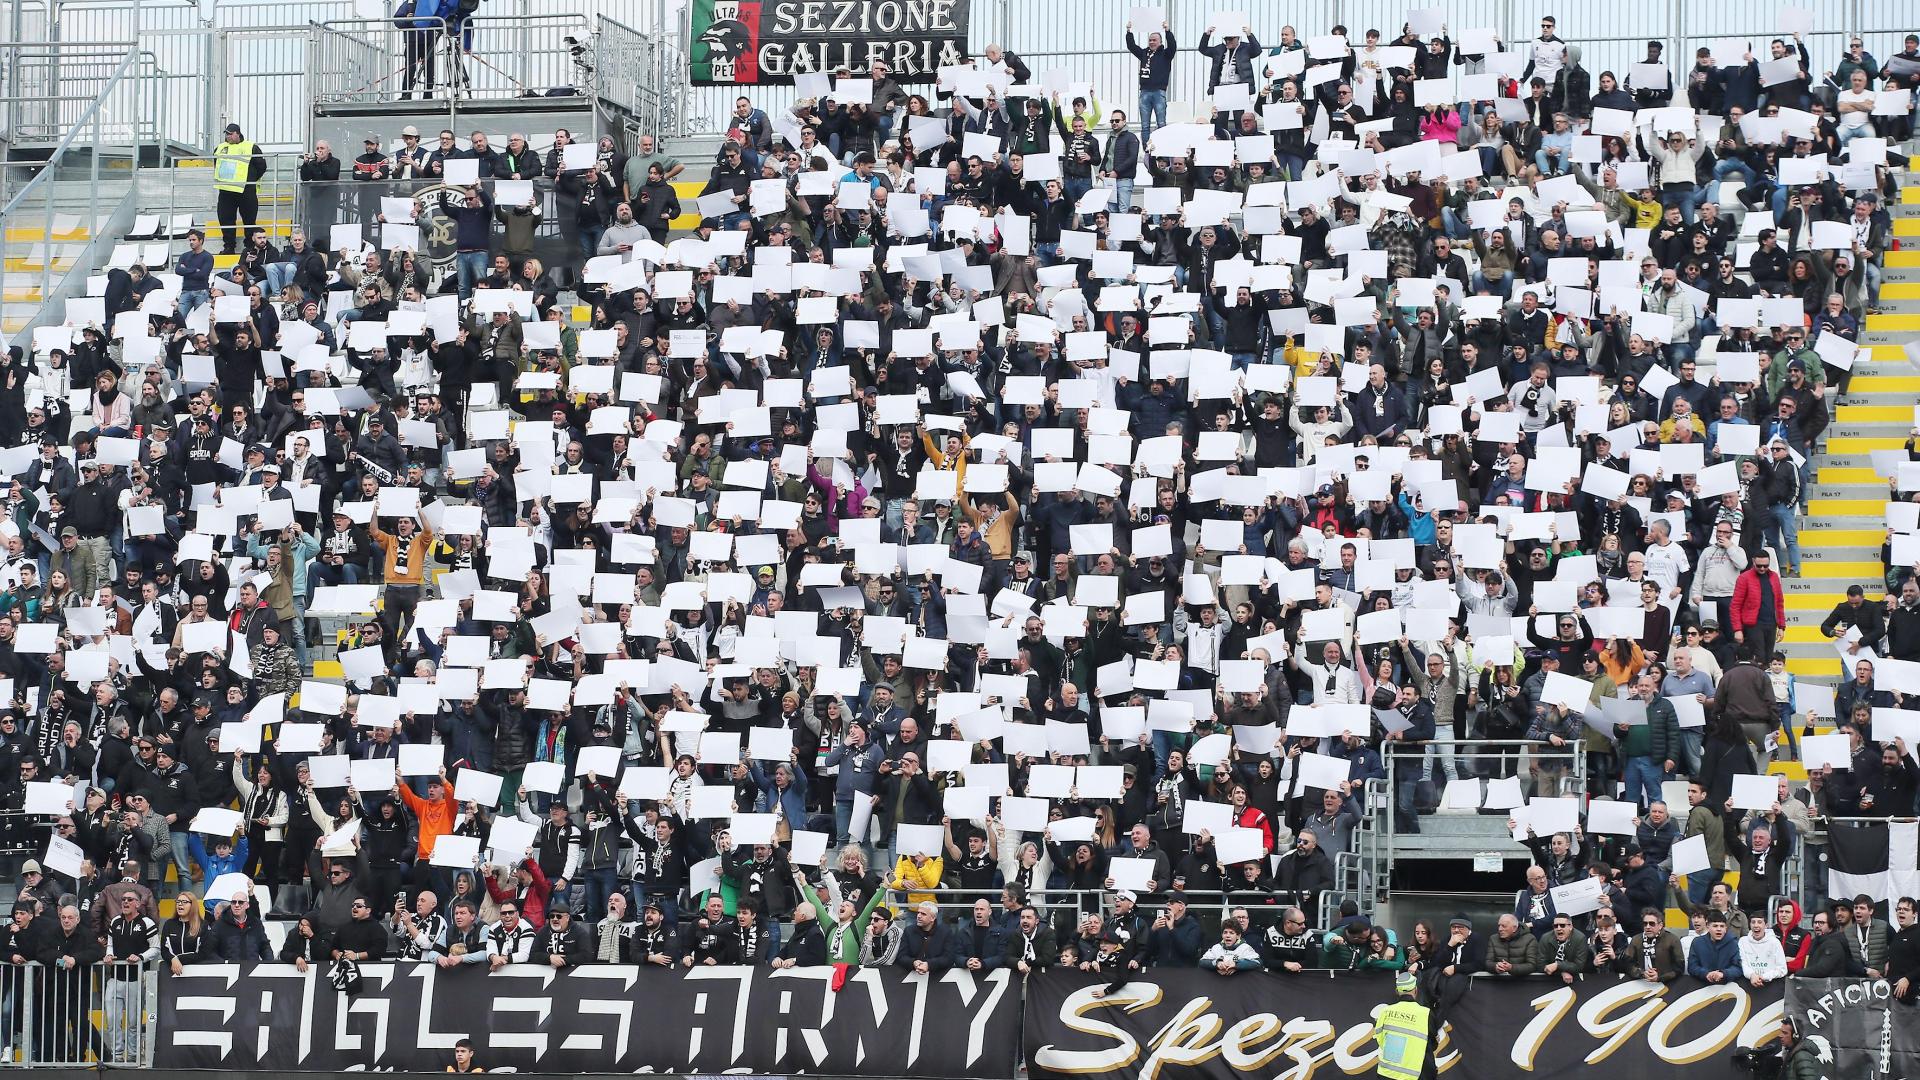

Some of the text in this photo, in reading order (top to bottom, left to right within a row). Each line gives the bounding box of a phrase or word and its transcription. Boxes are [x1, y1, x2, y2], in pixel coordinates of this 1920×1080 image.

[708, 7, 750, 22] ULTRAS
[772, 0, 957, 33] SEZIONE
[708, 62, 748, 77] SPEZIA
[758, 40, 961, 76] GALLERIA
[190, 450, 211, 459] SPEZIA
[172, 963, 1011, 1069] EAGLES ARMY
